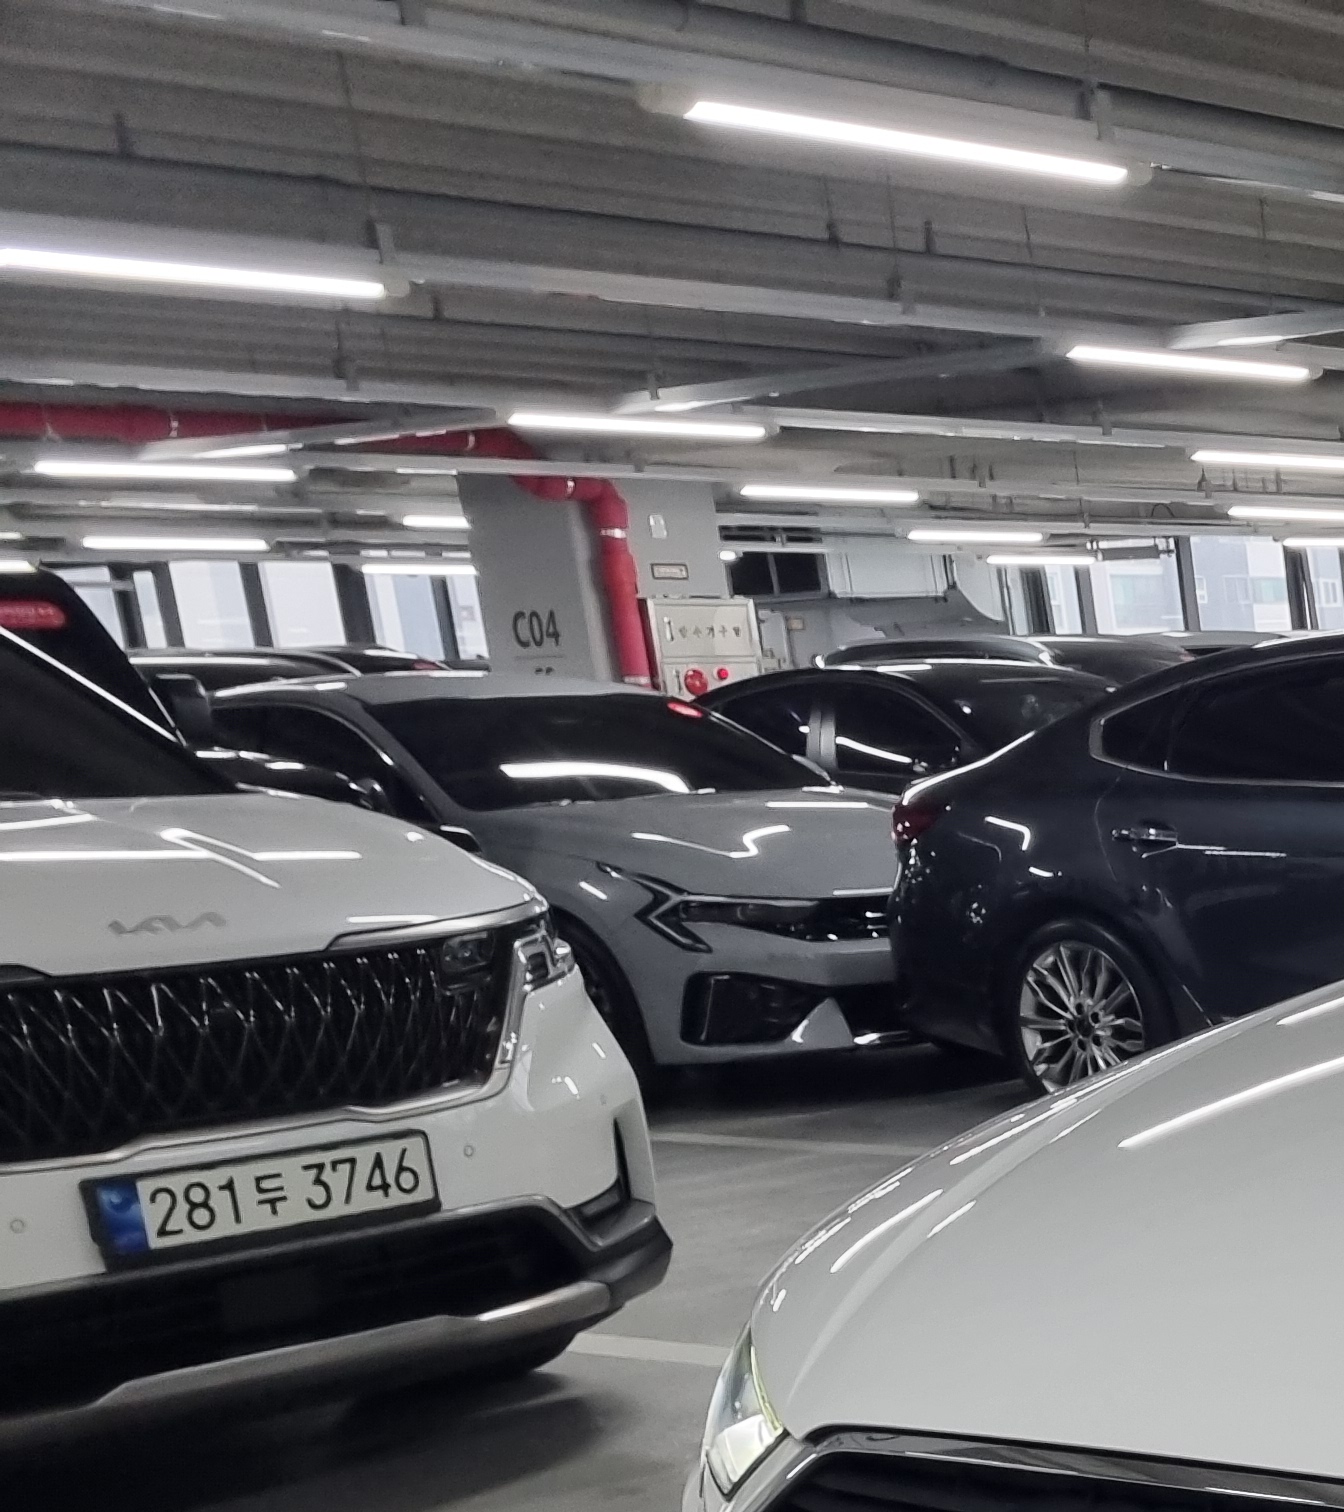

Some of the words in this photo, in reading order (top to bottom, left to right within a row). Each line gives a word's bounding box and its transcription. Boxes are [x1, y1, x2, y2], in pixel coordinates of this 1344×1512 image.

[512, 609, 560, 649] C04
[150, 1173, 287, 1238] 281두
[302, 1147, 420, 1210] 3746
